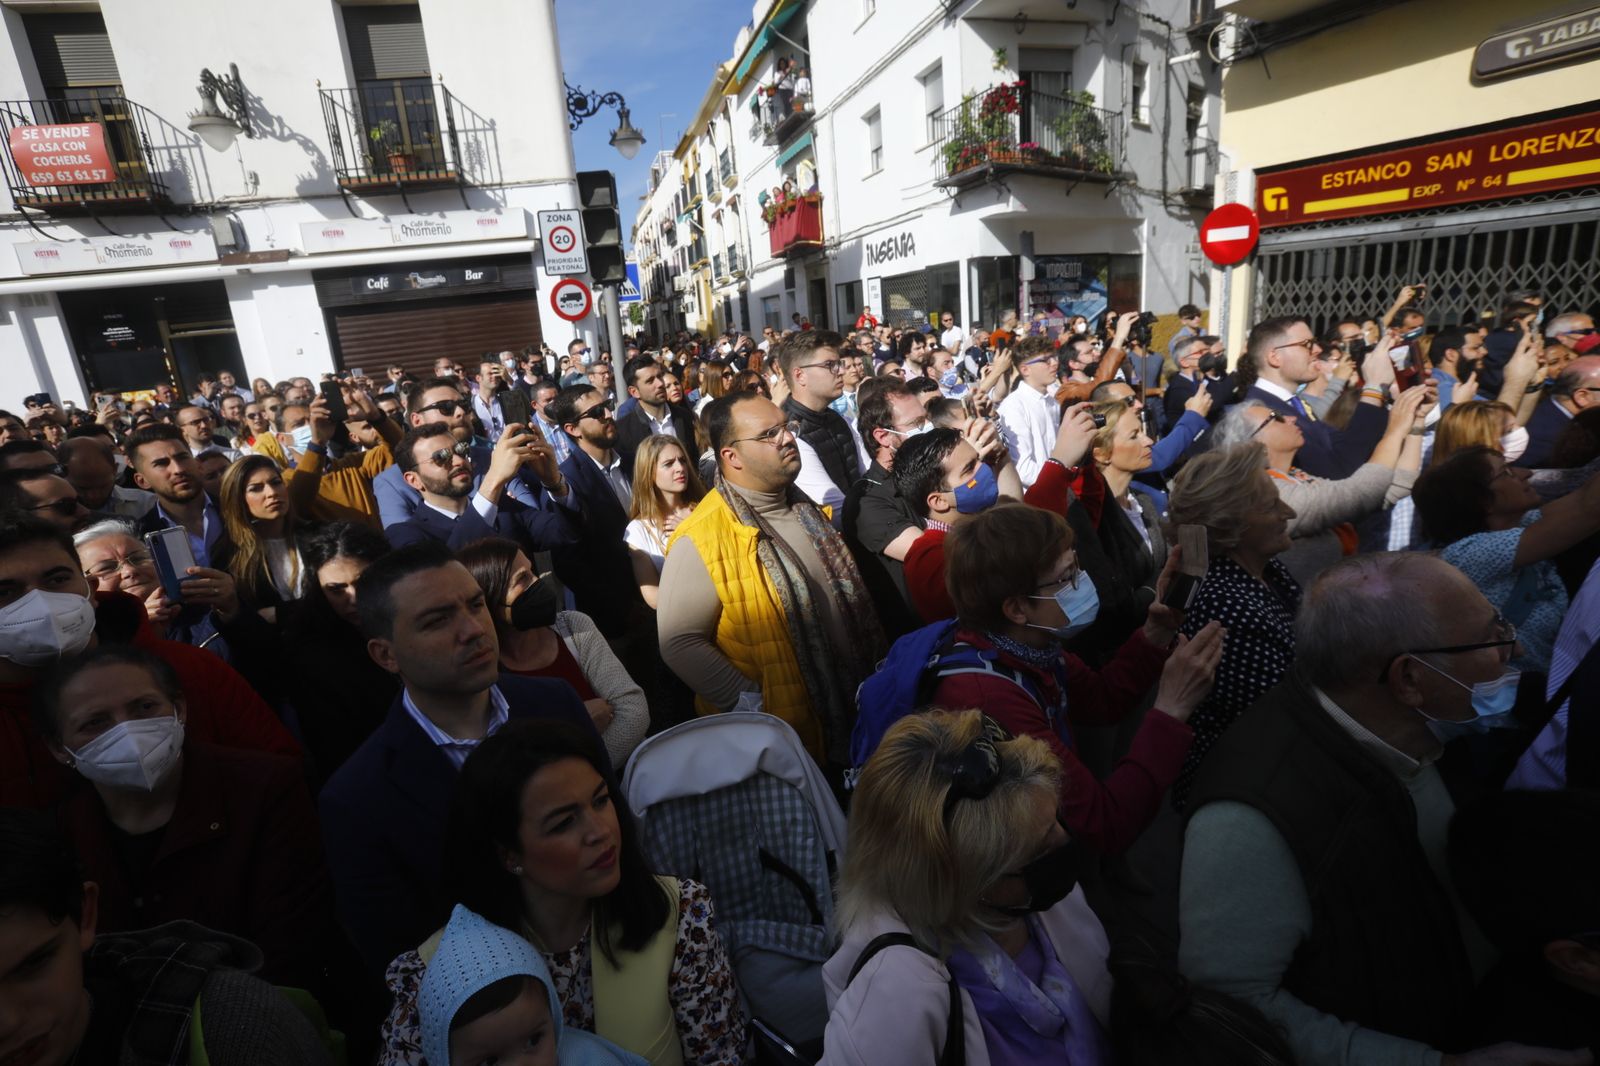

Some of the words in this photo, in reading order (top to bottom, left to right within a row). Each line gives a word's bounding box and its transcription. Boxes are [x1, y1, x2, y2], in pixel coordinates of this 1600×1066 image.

[22, 128, 39, 140] SE
[42, 126, 90, 139] VENDE
[30, 143, 60, 153] CASA
[62, 141, 87, 151] CON
[33, 154, 93, 167] COCHERAS
[31, 171, 55, 183] 659
[57, 170, 73, 182] 63
[74, 170, 91, 181] 61
[92, 169, 107, 181] 57
[1321, 160, 1412, 190] ESTANCO
[1425, 149, 1473, 173] SAN
[1413, 183, 1445, 198] EXP.
[1482, 174, 1502, 188] 64
[547, 214, 573, 222] ZONA
[554, 235, 570, 244] 20
[547, 256, 583, 265] PRIORIDAD
[548, 264, 584, 272] PEATONAL
[367, 277, 389, 290] Café
[464, 269, 483, 281] Bar
